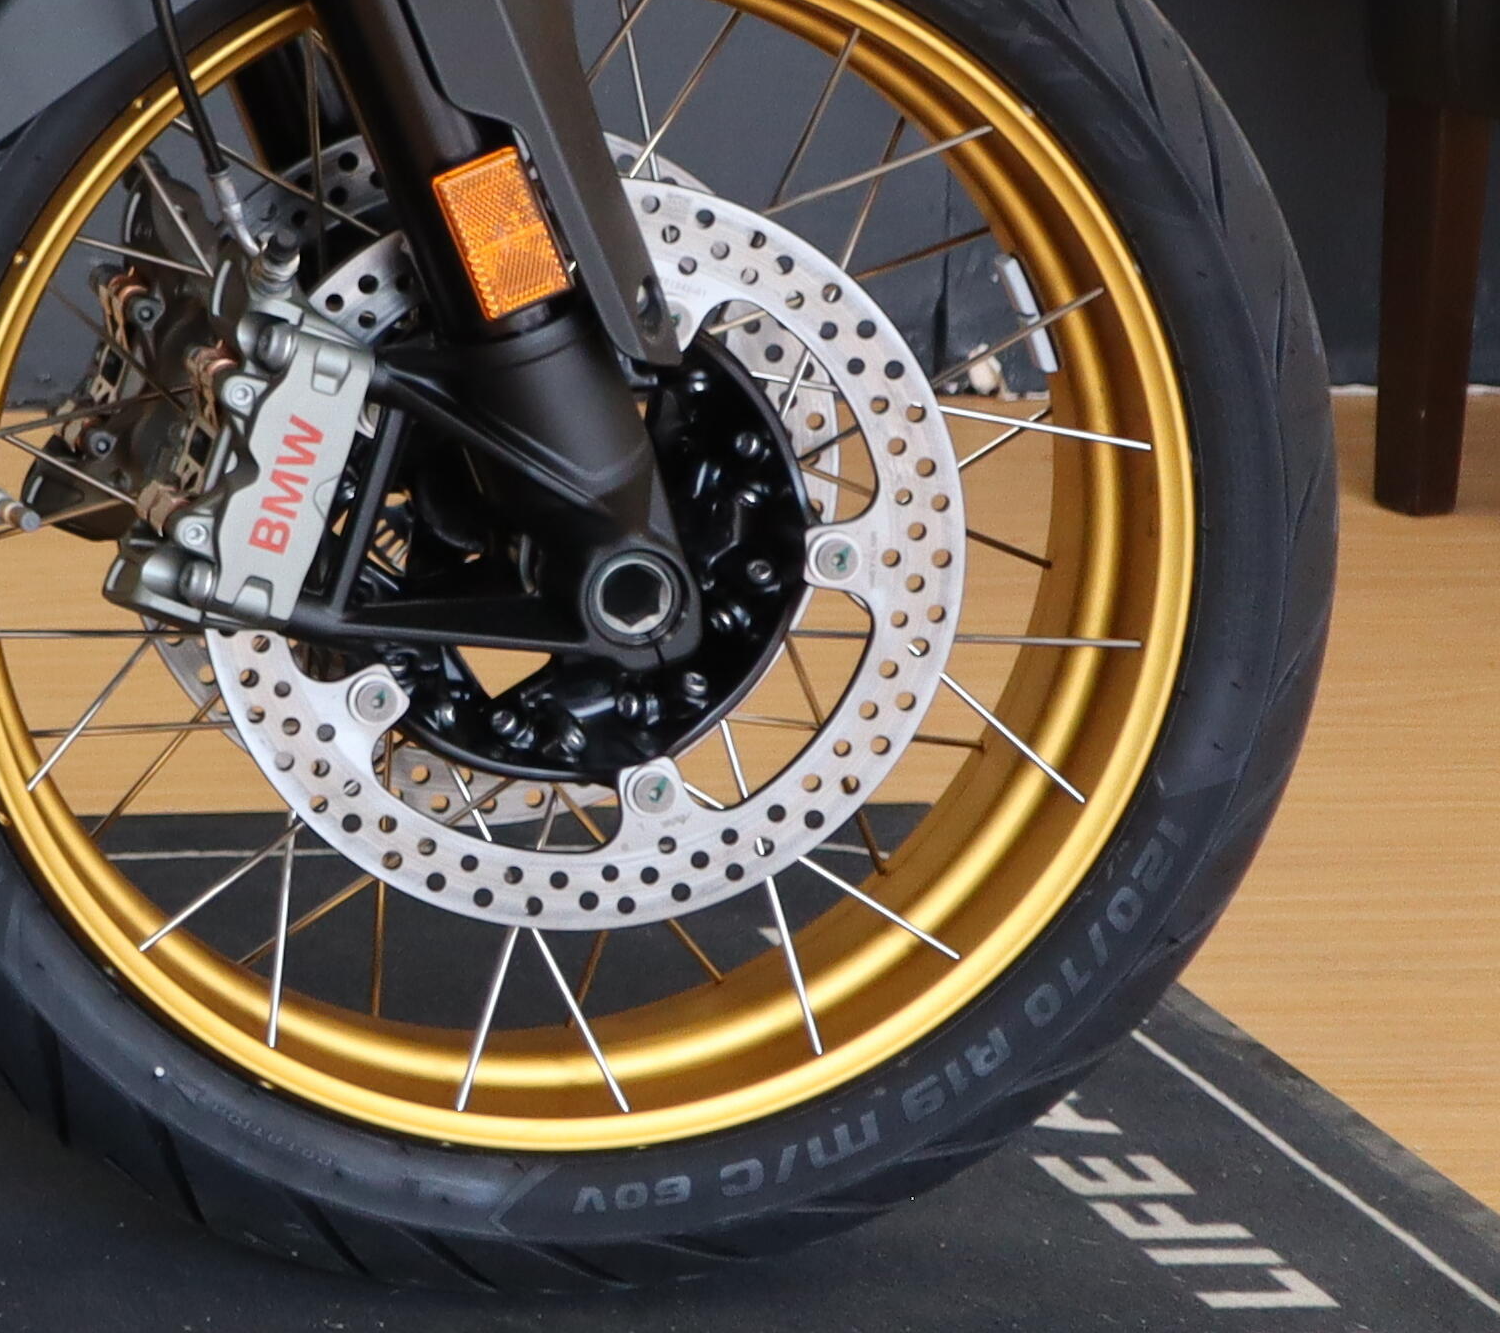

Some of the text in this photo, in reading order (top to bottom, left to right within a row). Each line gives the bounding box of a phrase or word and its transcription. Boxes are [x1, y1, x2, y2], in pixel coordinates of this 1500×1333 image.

[248, 414, 325, 556] BMW
[1022, 817, 1190, 1027] 120/70
[900, 1023, 1018, 1125] R19
[570, 1173, 694, 1216] 60V
[1032, 1153, 1341, 1310] LIFE
